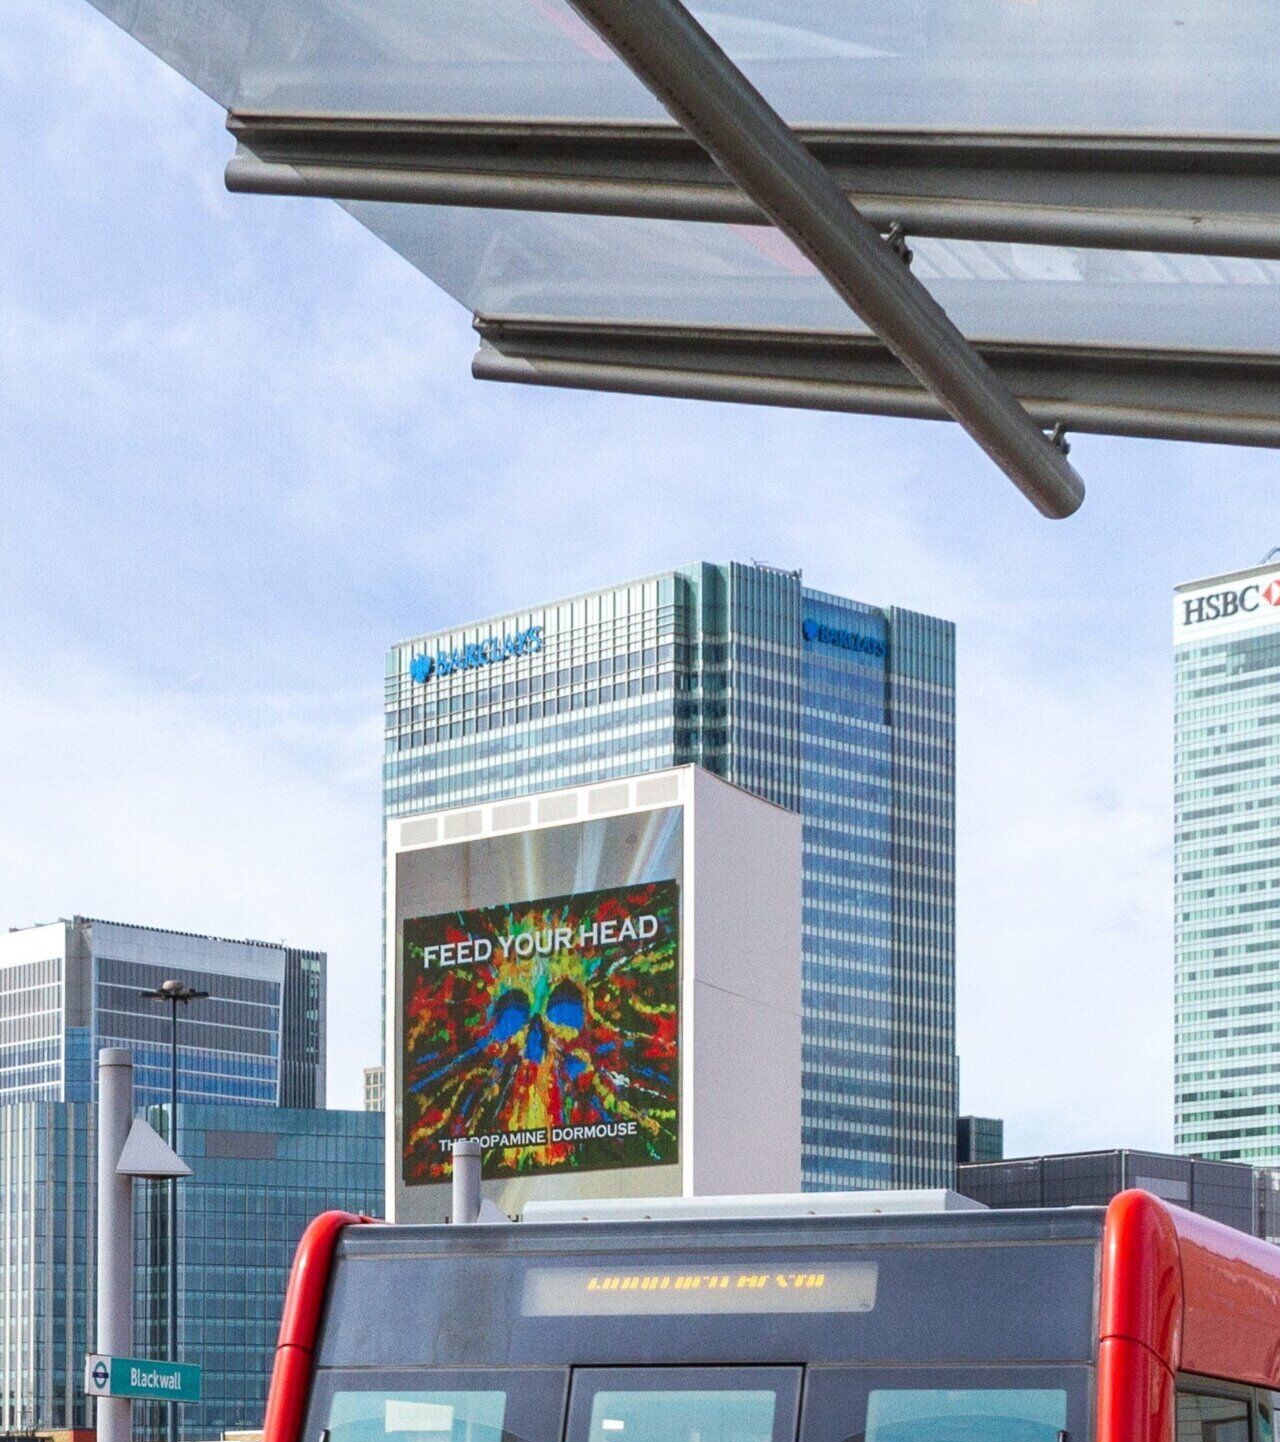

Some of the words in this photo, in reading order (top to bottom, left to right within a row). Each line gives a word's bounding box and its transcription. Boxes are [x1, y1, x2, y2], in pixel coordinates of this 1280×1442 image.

[1183, 584, 1260, 625] HSBC
[436, 625, 543, 677] BARCLAYS
[423, 938, 492, 969] FEED
[497, 927, 572, 958] YOUR
[579, 915, 659, 947] HEAD
[552, 1121, 638, 1142] DORMOUSE
[130, 1367, 182, 1391] Blackwall
